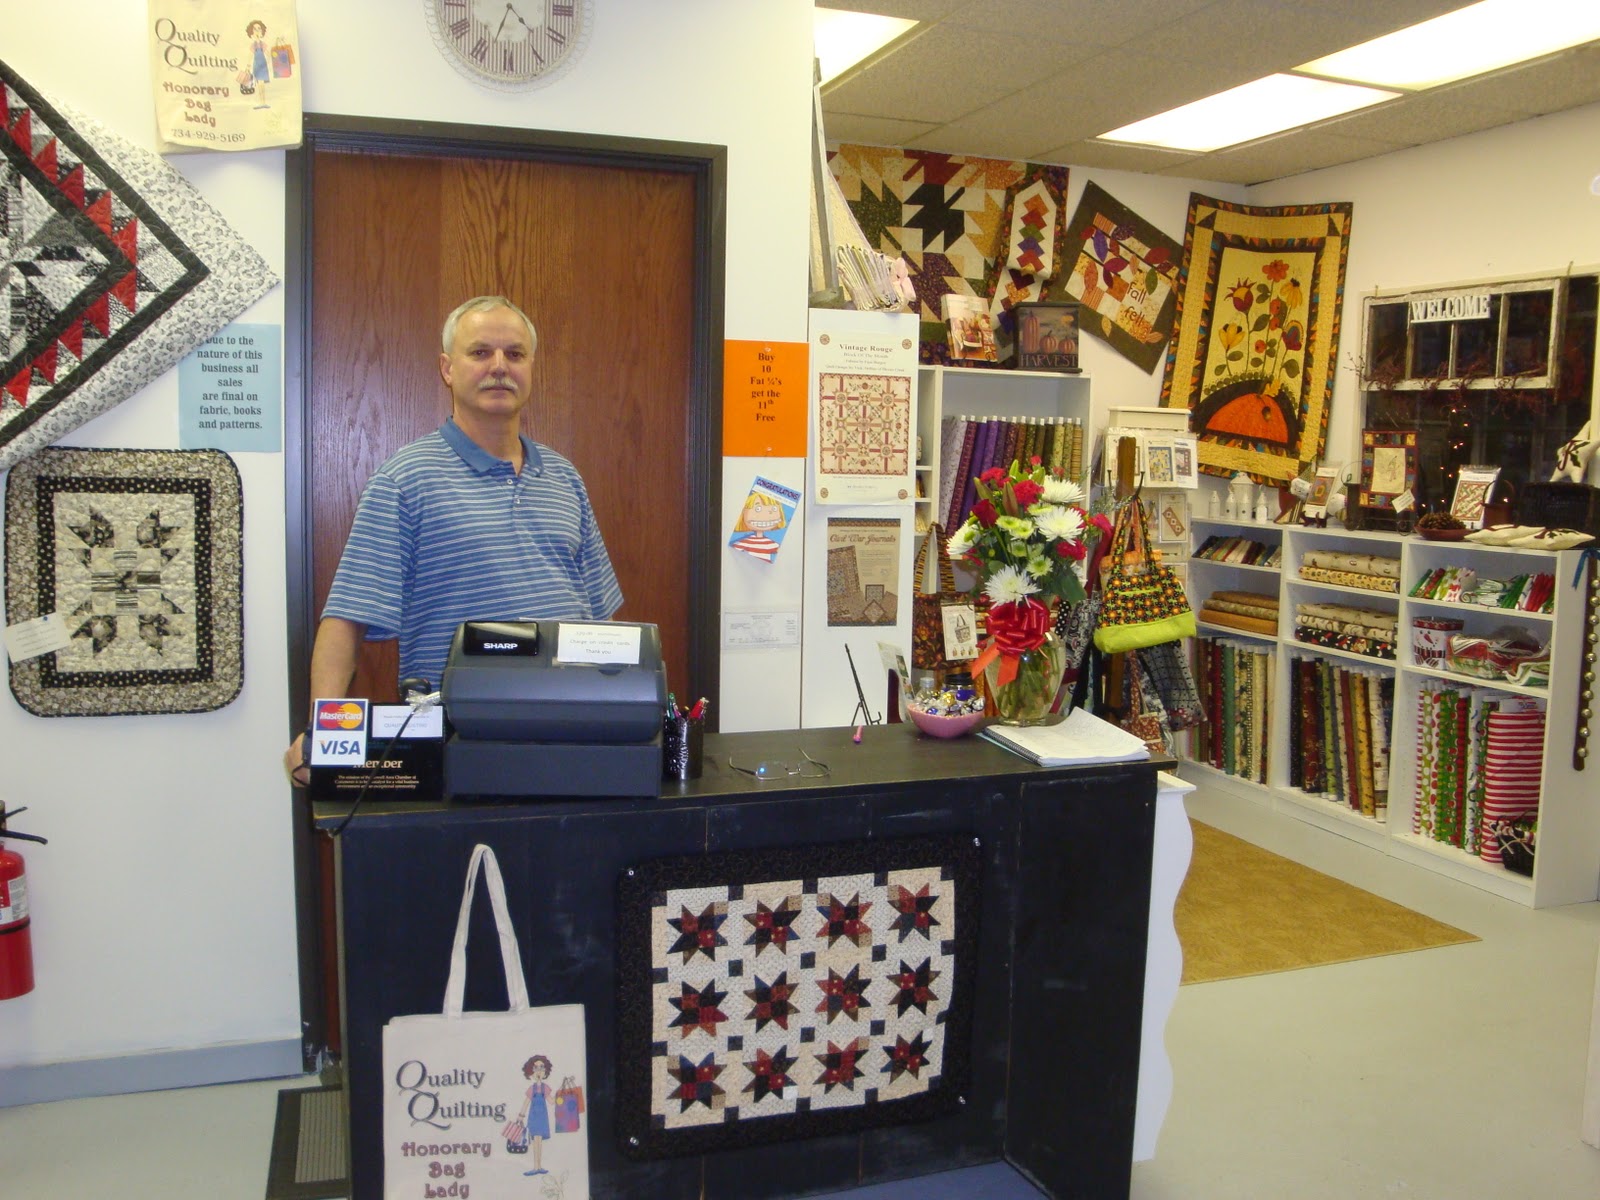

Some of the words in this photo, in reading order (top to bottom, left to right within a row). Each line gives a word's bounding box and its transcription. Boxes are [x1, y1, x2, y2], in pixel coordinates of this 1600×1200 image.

[155, 18, 220, 47] Quality
[164, 45, 238, 75] Quilting
[163, 81, 229, 97] Honorary
[184, 98, 212, 112] Bag
[184, 112, 216, 127] Lady
[170, 128, 246, 143] 734-929-5169
[1127, 281, 1147, 304] fall
[1411, 294, 1491, 321] WELCOME
[1124, 306, 1146, 325] fell
[227, 336, 236, 345] to
[238, 336, 254, 345] the
[197, 350, 230, 359] nature
[232, 350, 243, 359] of
[244, 350, 263, 360] this
[839, 343, 868, 352] Vintage
[870, 345, 893, 353] Rouge
[758, 352, 775, 363] Buy
[1021, 354, 1079, 368] HARVEST
[201, 363, 244, 373] business
[246, 364, 259, 373] all
[762, 365, 772, 373] 10
[217, 378, 243, 387] sales
[750, 376, 765, 385] Fat
[202, 392, 219, 401] are
[221, 391, 244, 401] final
[246, 393, 258, 401] on
[751, 390, 764, 399] get
[767, 389, 780, 398] the
[199, 405, 231, 416] fabric,
[233, 405, 262, 415] books
[755, 413, 776, 422] Free
[198, 419, 217, 429] and
[219, 420, 263, 430] patterns.
[865, 533, 897, 545] Journals
[319, 711, 363, 720] MasterCard
[320, 740, 361, 755] VISA
[396, 1060, 485, 1096] Quality
[408, 1092, 507, 1130] Quilting
[401, 1142, 492, 1157] Honorary
[428, 1161, 466, 1178] Bag
[424, 1181, 470, 1200] Lady
